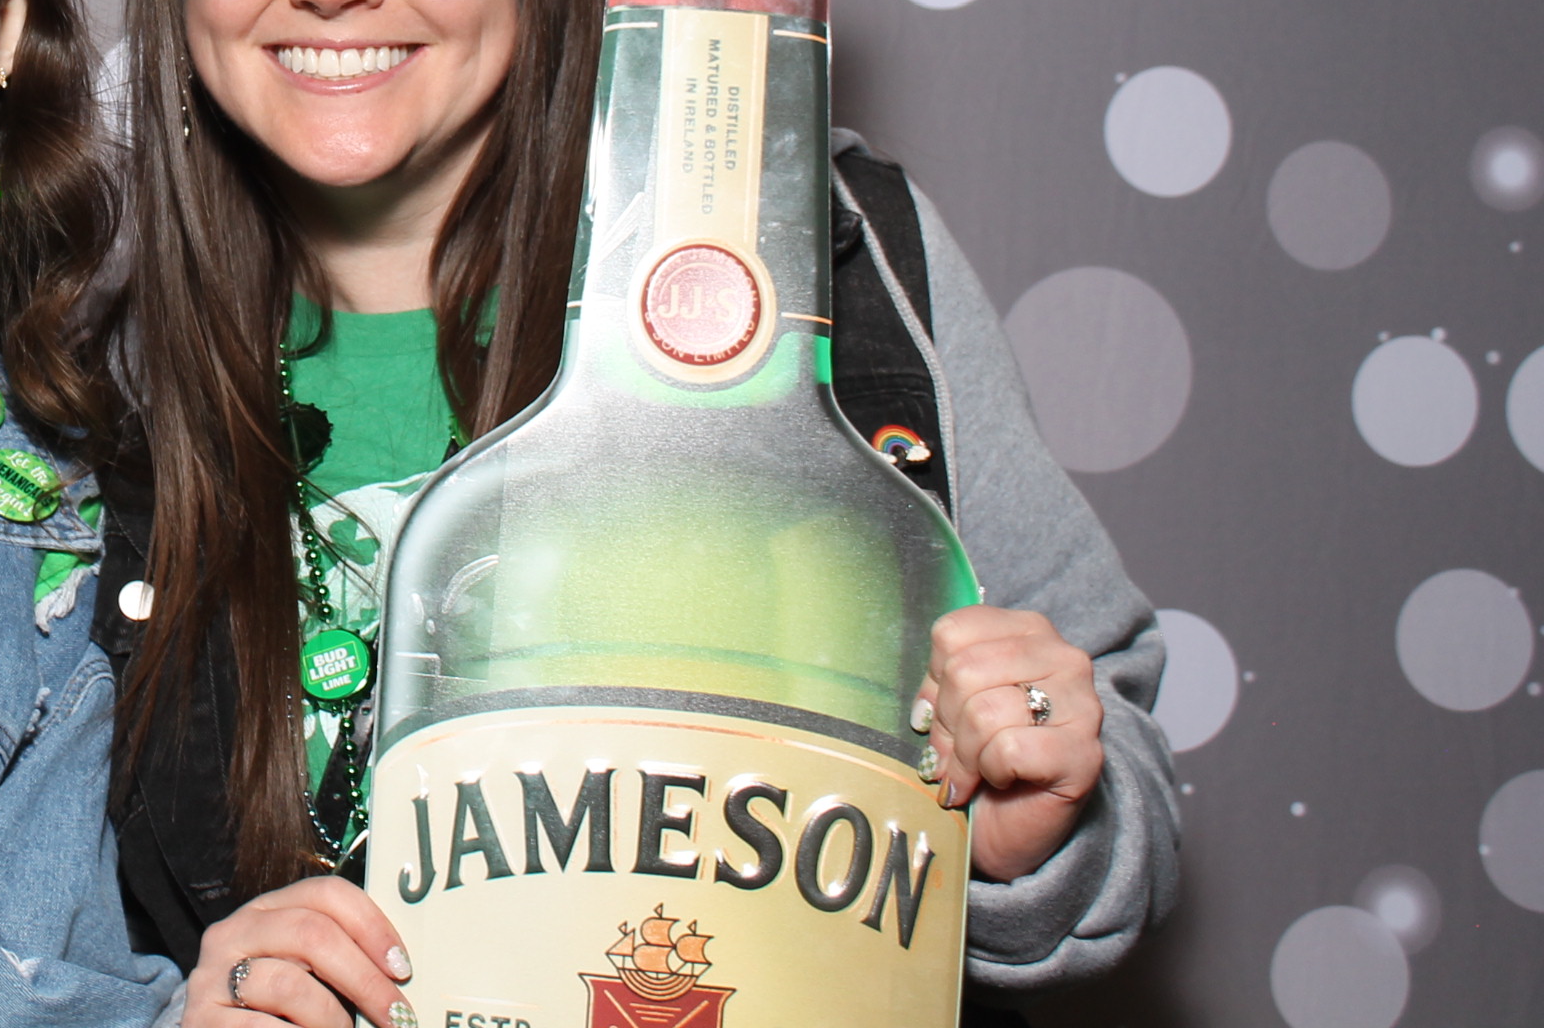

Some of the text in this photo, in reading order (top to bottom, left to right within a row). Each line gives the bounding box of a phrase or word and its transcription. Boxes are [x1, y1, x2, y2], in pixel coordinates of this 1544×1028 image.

[682, 77, 698, 174] IN IRELAND
[701, 38, 721, 215] MATURED & BOTTLED
[724, 86, 740, 171] DISTILLED
[5, 451, 50, 486] Let the
[309, 655, 356, 681] LIGHT
[312, 647, 348, 668] BUD
[321, 674, 353, 692] LIME
[398, 762, 937, 951] JAMESON
